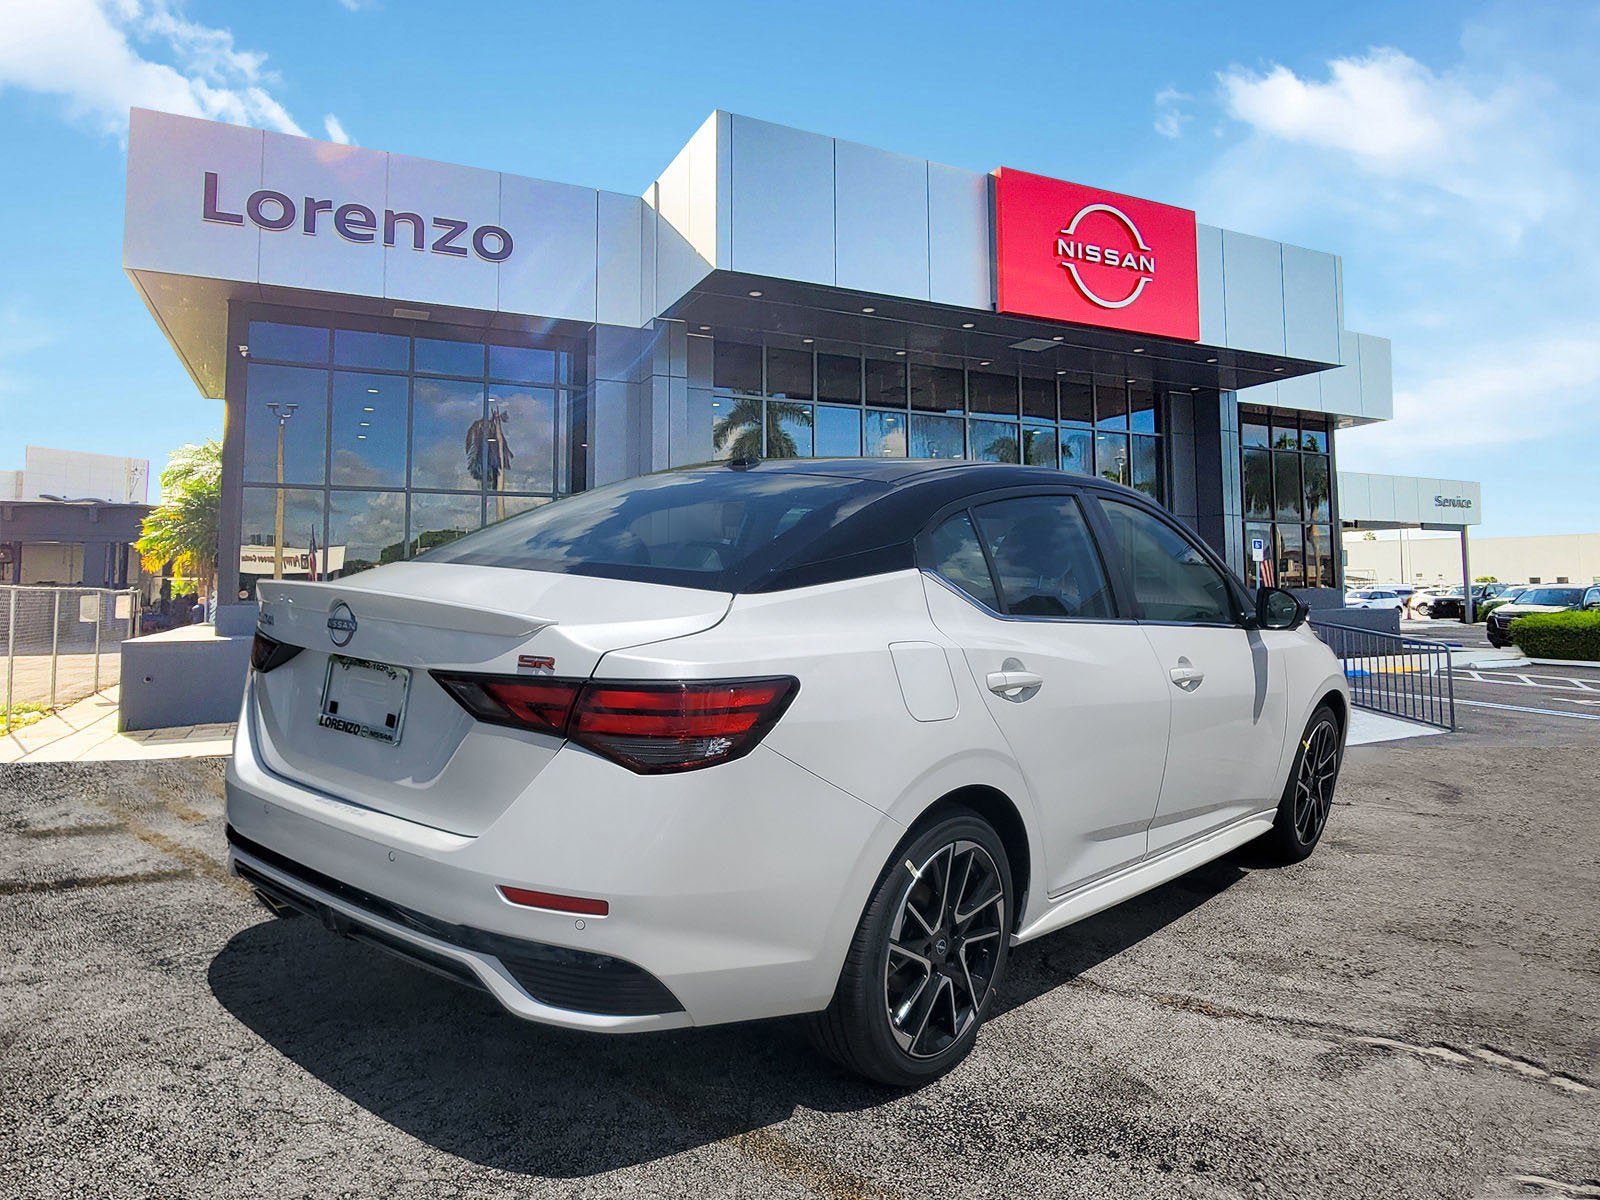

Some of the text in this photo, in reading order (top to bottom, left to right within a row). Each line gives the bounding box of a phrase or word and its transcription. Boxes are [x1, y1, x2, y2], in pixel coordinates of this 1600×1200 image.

[202, 171, 515, 263] Lorenzo
[1057, 238, 1155, 273] NISSAN
[1434, 495, 1472, 508] Service
[518, 655, 555, 670] SR
[319, 715, 394, 741] LORENZO NISSAN
